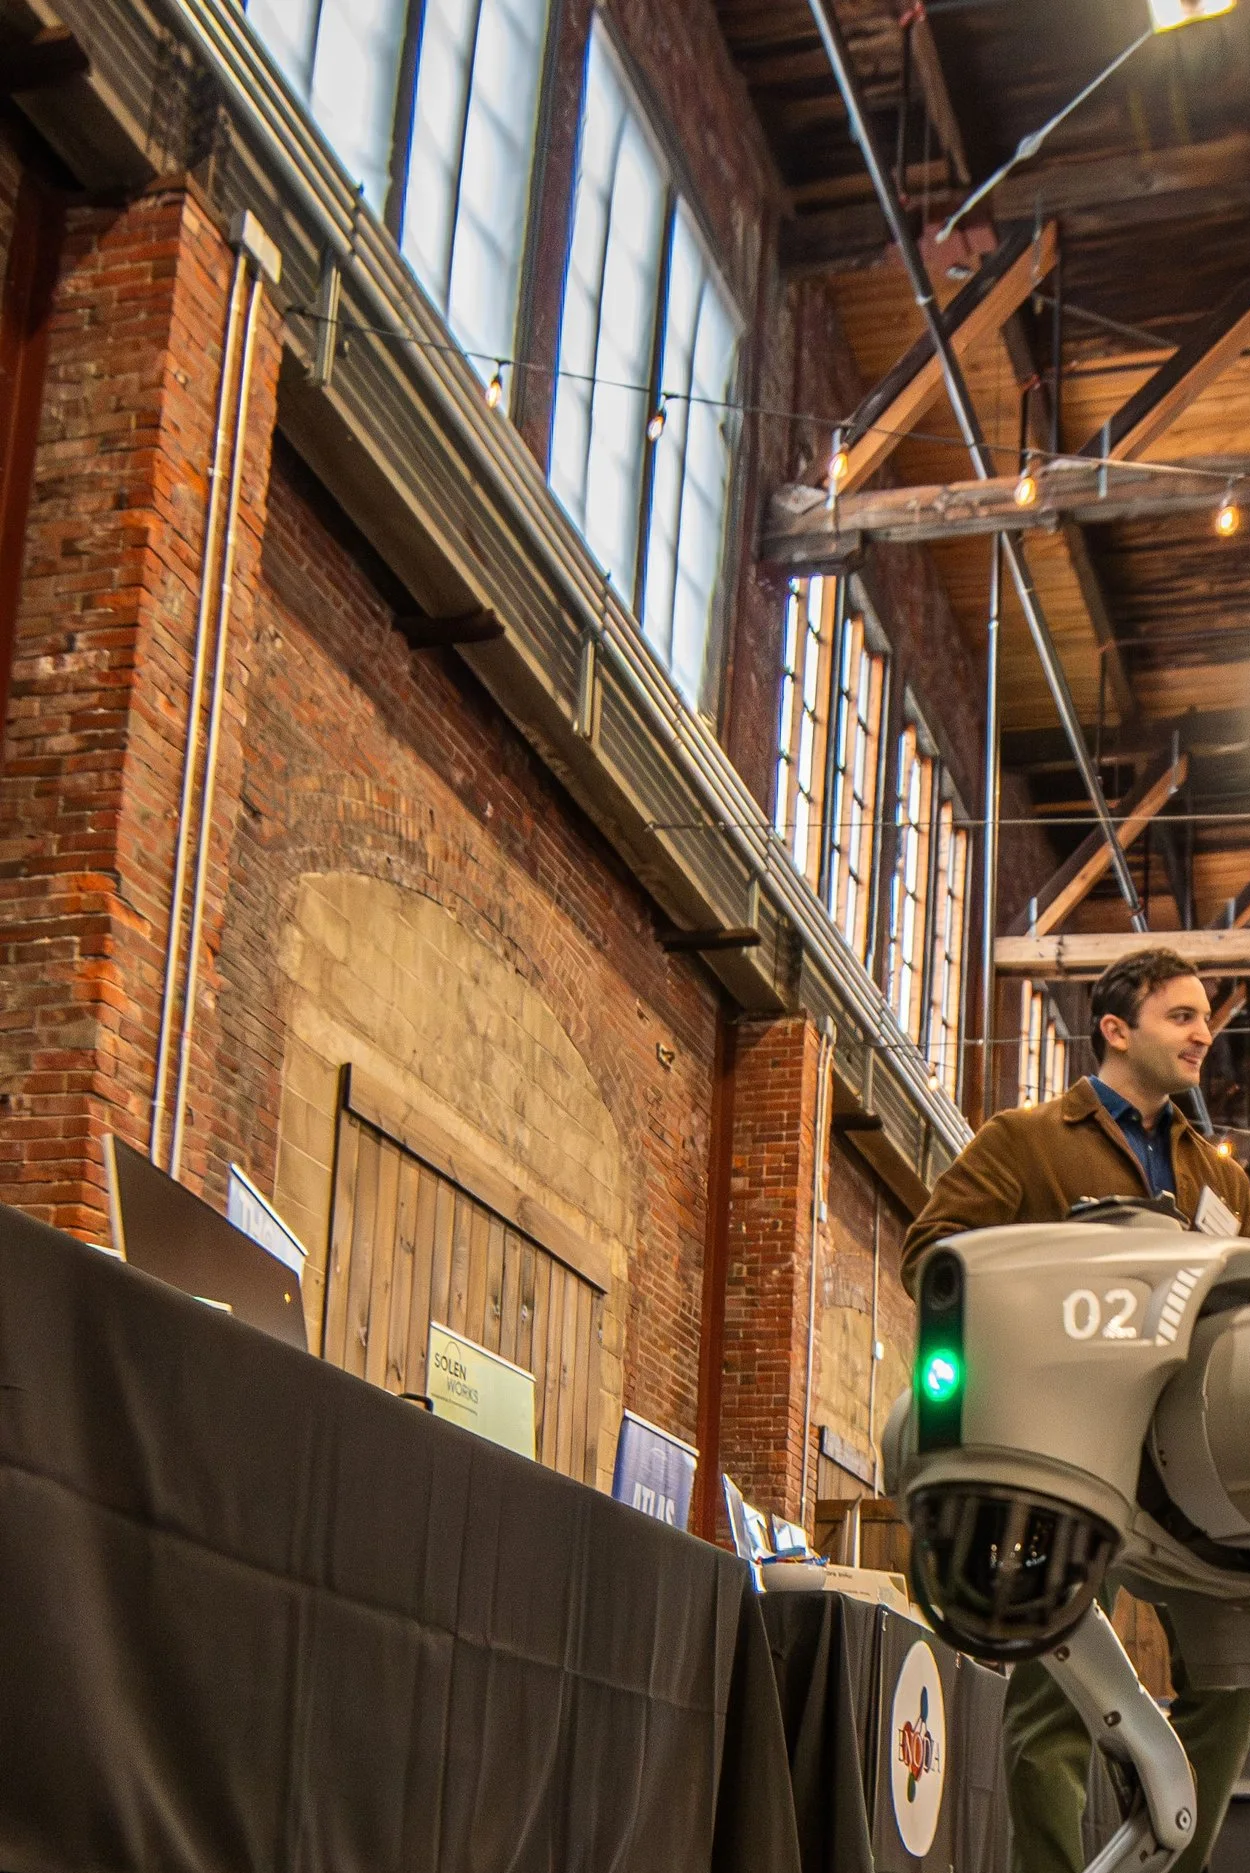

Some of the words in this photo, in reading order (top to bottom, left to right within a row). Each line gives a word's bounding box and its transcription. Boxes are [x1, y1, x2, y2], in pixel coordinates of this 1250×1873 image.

[1063, 1288, 1138, 1340] 02
[434, 1352, 467, 1381] SOLEN
[447, 1377, 479, 1404] WORKS
